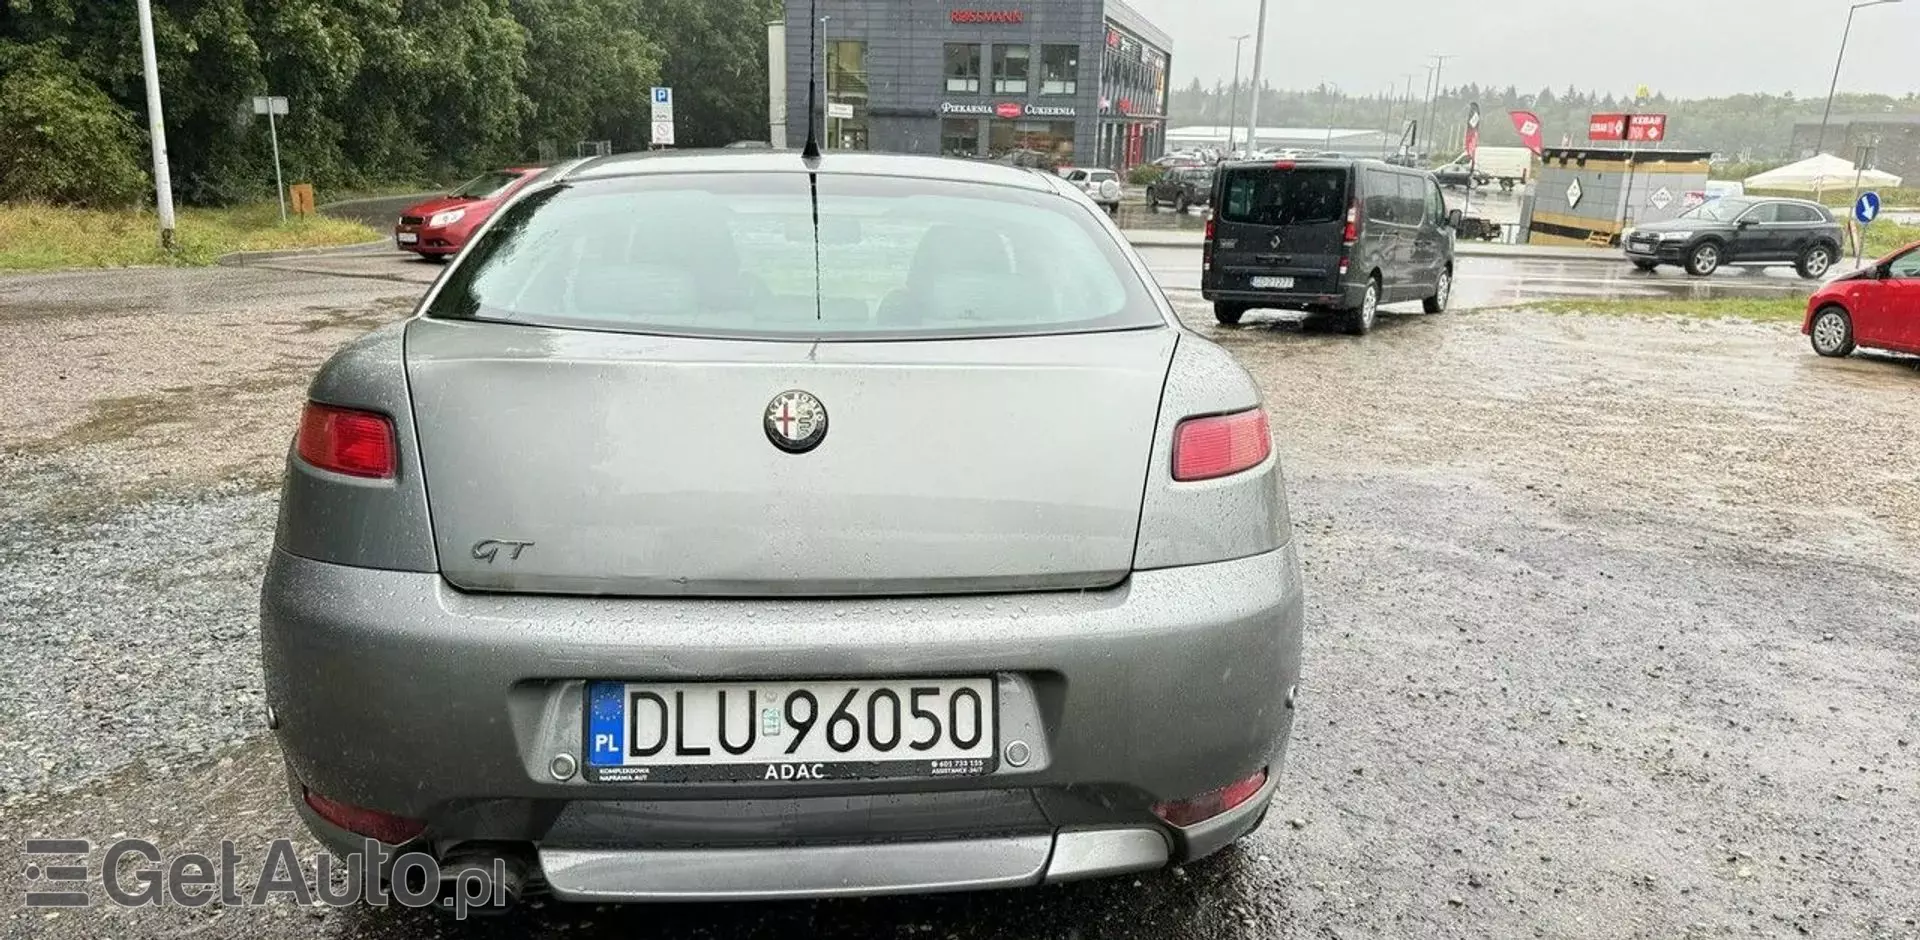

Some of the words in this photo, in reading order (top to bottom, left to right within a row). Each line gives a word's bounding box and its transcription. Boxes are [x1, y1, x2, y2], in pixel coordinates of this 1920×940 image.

[950, 10, 1023, 24] ROSSMANN
[941, 102, 993, 114] PIEKARNIA
[1024, 104, 1076, 116] CUKIERNIA
[1632, 116, 1662, 125] KEBAB
[472, 539, 536, 564] GT
[595, 734, 619, 752] PL
[629, 689, 757, 757] DLU
[784, 686, 983, 755] 96050
[764, 763, 826, 780] ADAC
